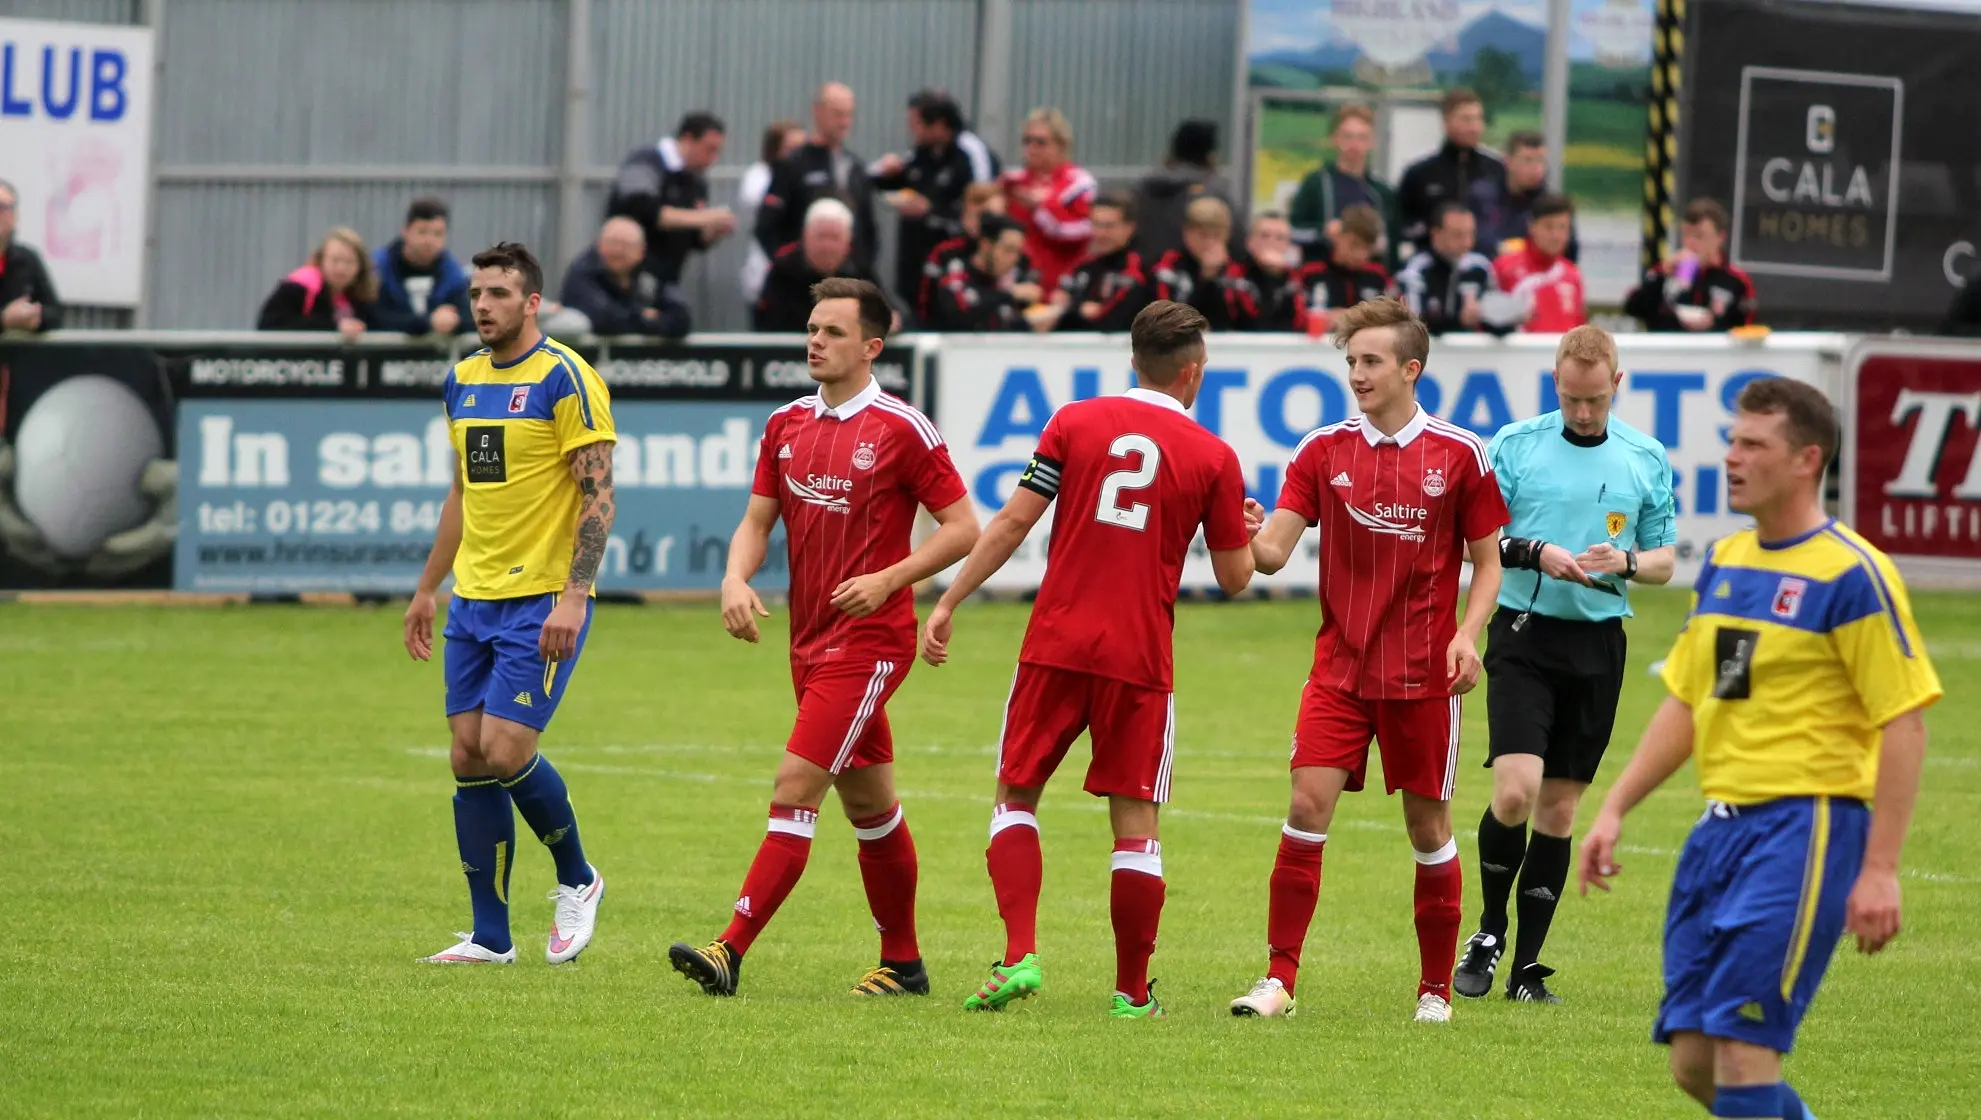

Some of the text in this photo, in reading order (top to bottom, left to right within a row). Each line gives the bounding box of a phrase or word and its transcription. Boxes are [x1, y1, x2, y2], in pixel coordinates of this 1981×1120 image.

[1761, 157, 1872, 208] CALA
[1758, 211, 1869, 248] HOMES
[192, 360, 344, 385] MOTORCYCLE
[200, 415, 290, 487] In
[471, 451, 499, 463] CALA
[471, 466, 500, 474] HOMES
[807, 474, 852, 491] Saltire
[1095, 432, 1161, 532] 2
[199, 502, 256, 532] tel:
[266, 501, 379, 533] 01224
[827, 505, 850, 514] energy
[1375, 503, 1427, 519] Saltire
[1400, 534, 1425, 542] energy
